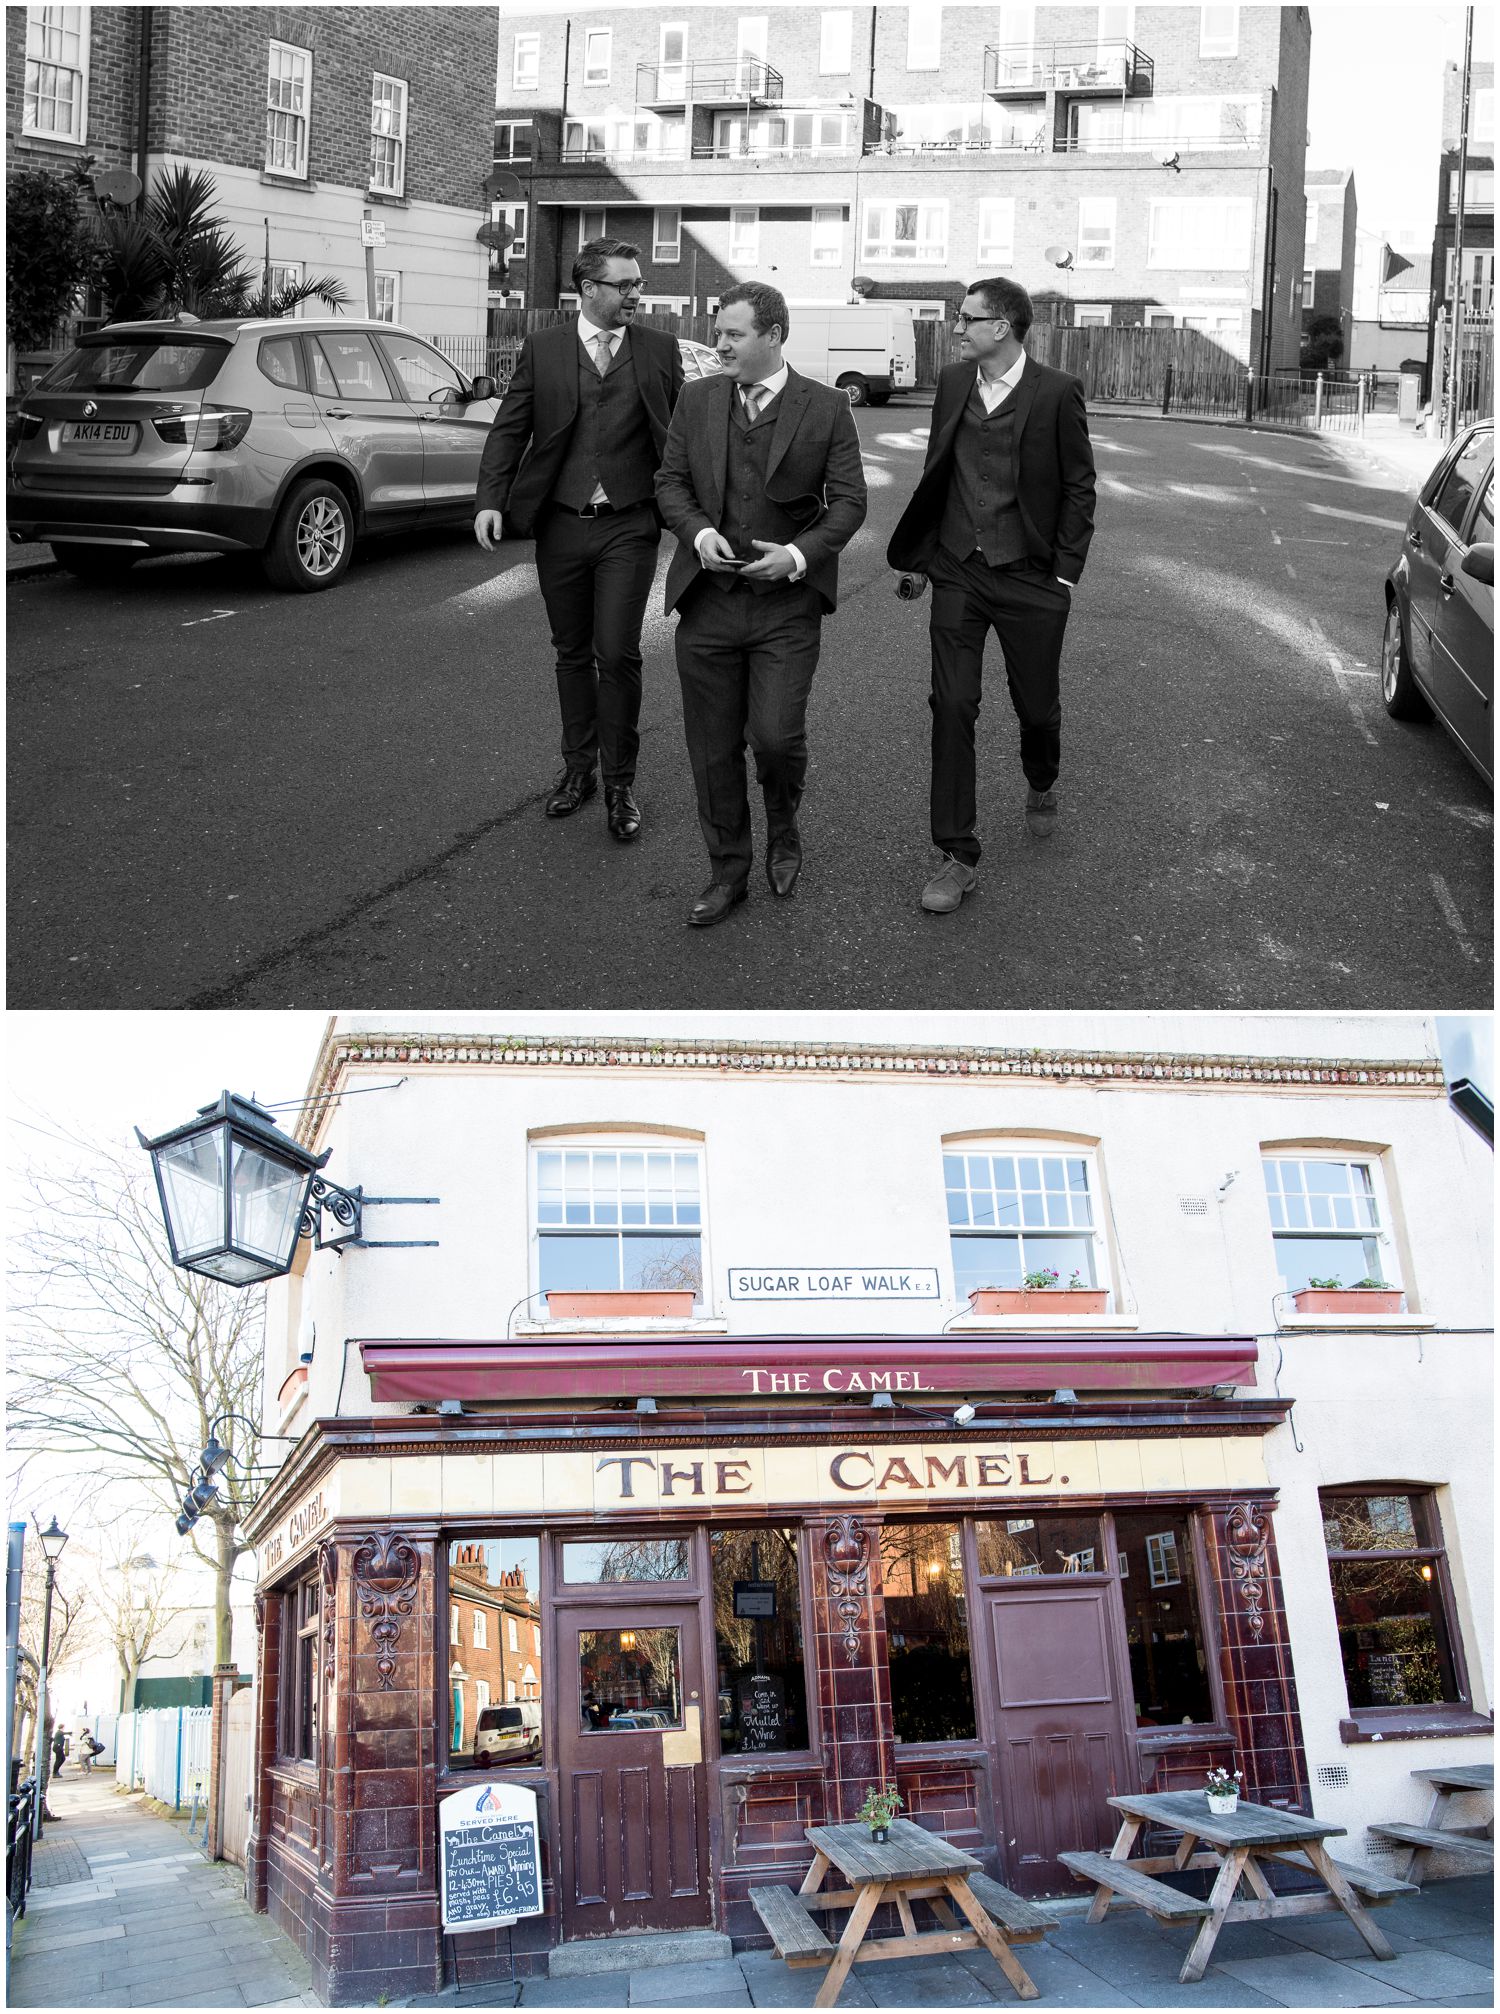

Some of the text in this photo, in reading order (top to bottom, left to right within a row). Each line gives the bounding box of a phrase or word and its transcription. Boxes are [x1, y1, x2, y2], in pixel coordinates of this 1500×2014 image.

[73, 425, 131, 441] AK14 EDU
[738, 1276, 800, 1292] SUGAR
[807, 1276, 853, 1291] LOAF
[861, 1275, 911, 1291] WALK
[742, 1369, 935, 1393] THE CAMEL.
[596, 1451, 1071, 1498] THE CAMEL.
[264, 1492, 327, 1571] THE CAMEL
[743, 1712, 781, 1727] Mulled
[750, 1727, 777, 1740] Wine
[460, 1818, 494, 1827] SERVED
[496, 1815, 519, 1823] HERE
[456, 1823, 520, 1845] The Camel
[450, 1841, 531, 1868] Lunchtime Special
[472, 1887, 487, 1896] with
[472, 1893, 491, 1904] peas
[493, 1880, 535, 1910] £6.95
